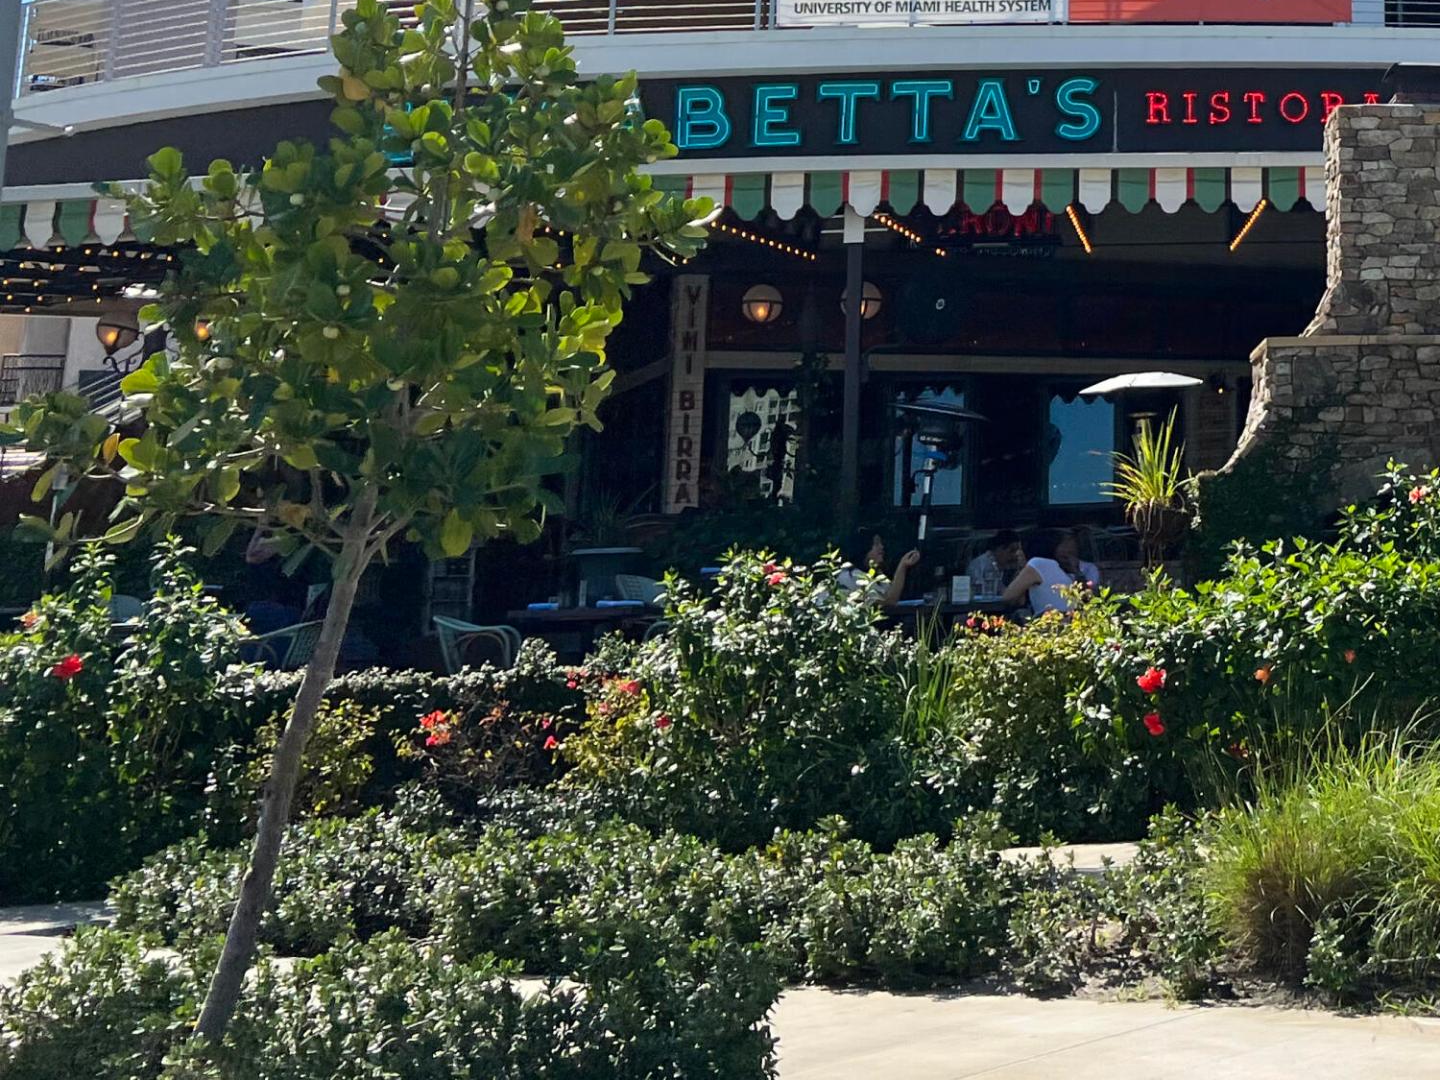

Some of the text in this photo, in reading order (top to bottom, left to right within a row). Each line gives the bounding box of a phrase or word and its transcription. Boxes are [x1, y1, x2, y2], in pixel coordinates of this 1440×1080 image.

[794, 0, 1052, 15] UNIVERSITY OF MIAMI HEALTH SYSTEM
[616, 76, 1102, 152] BETTA'S
[1144, 92, 1380, 126] RISTOR
[674, 389, 696, 505] BIRRA
